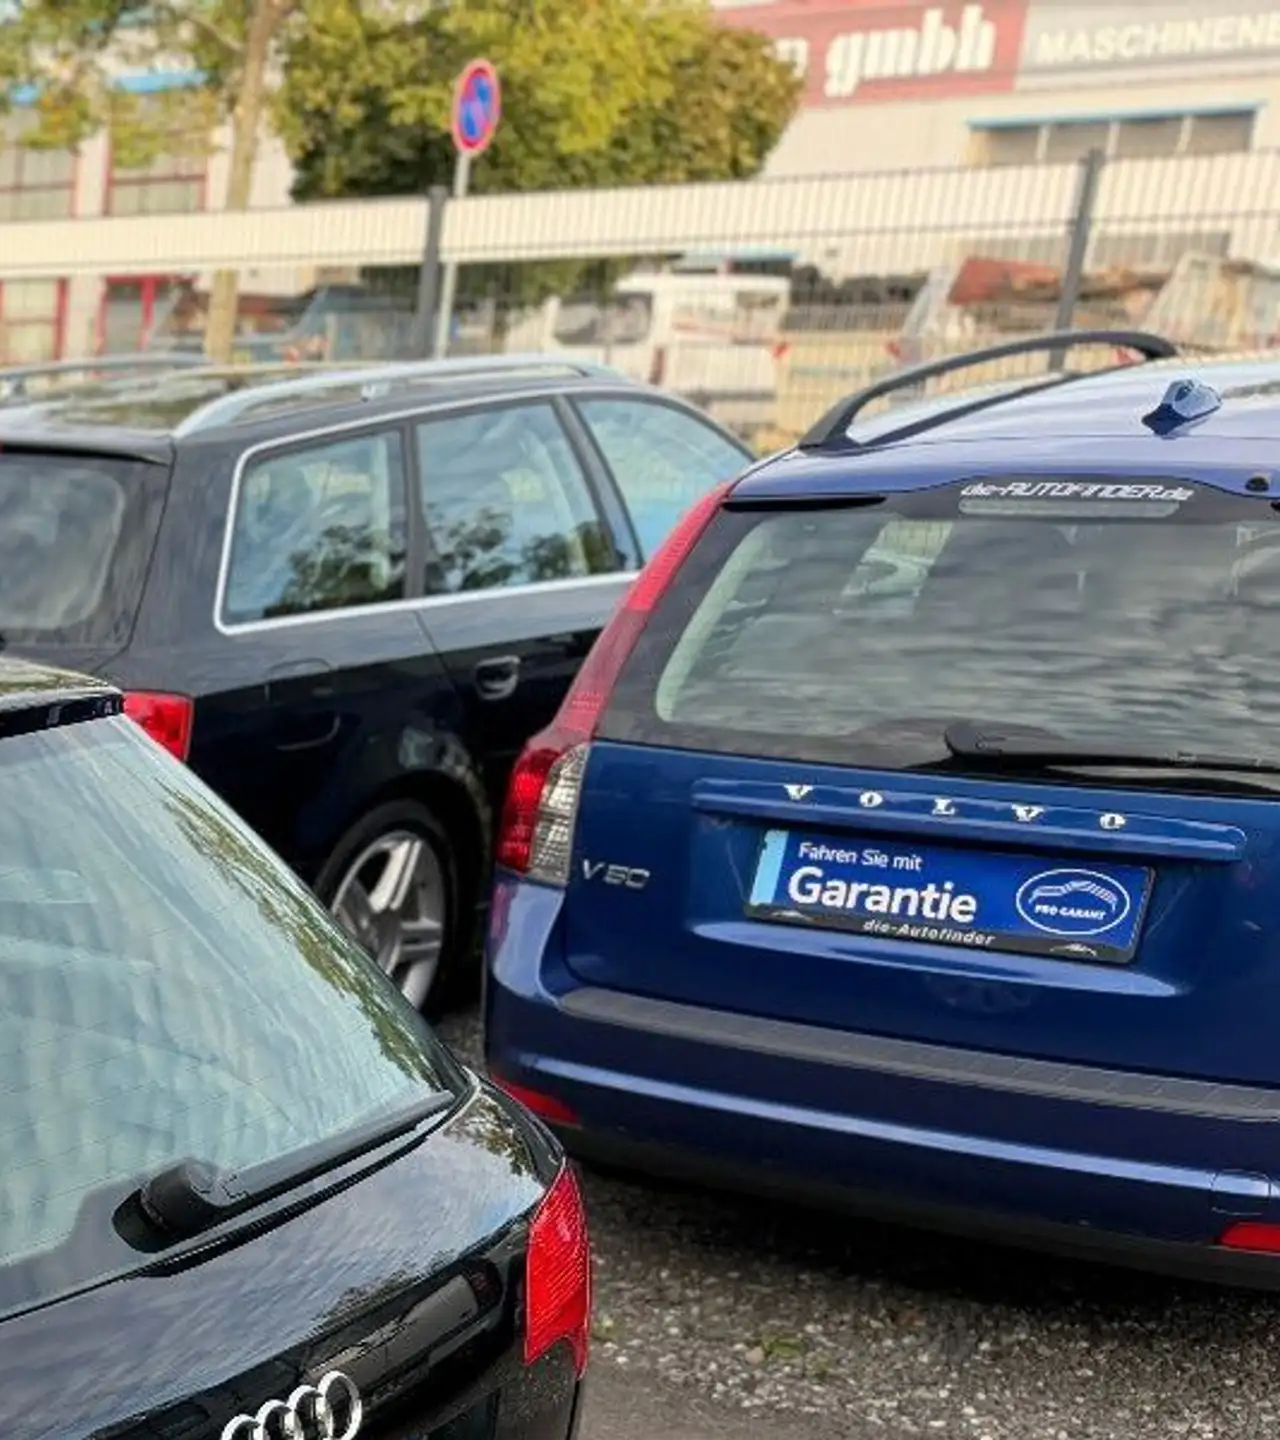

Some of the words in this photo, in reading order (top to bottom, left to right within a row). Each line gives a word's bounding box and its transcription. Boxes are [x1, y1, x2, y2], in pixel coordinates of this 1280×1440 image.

[824, 4, 996, 97] gmbh
[784, 784, 1127, 830] VOLVO
[798, 842, 858, 865] Fahren
[861, 849, 889, 868] Sie
[892, 855, 924, 872] mit
[788, 866, 977, 924] Garantie
[862, 919, 996, 946] die-Autofinder
